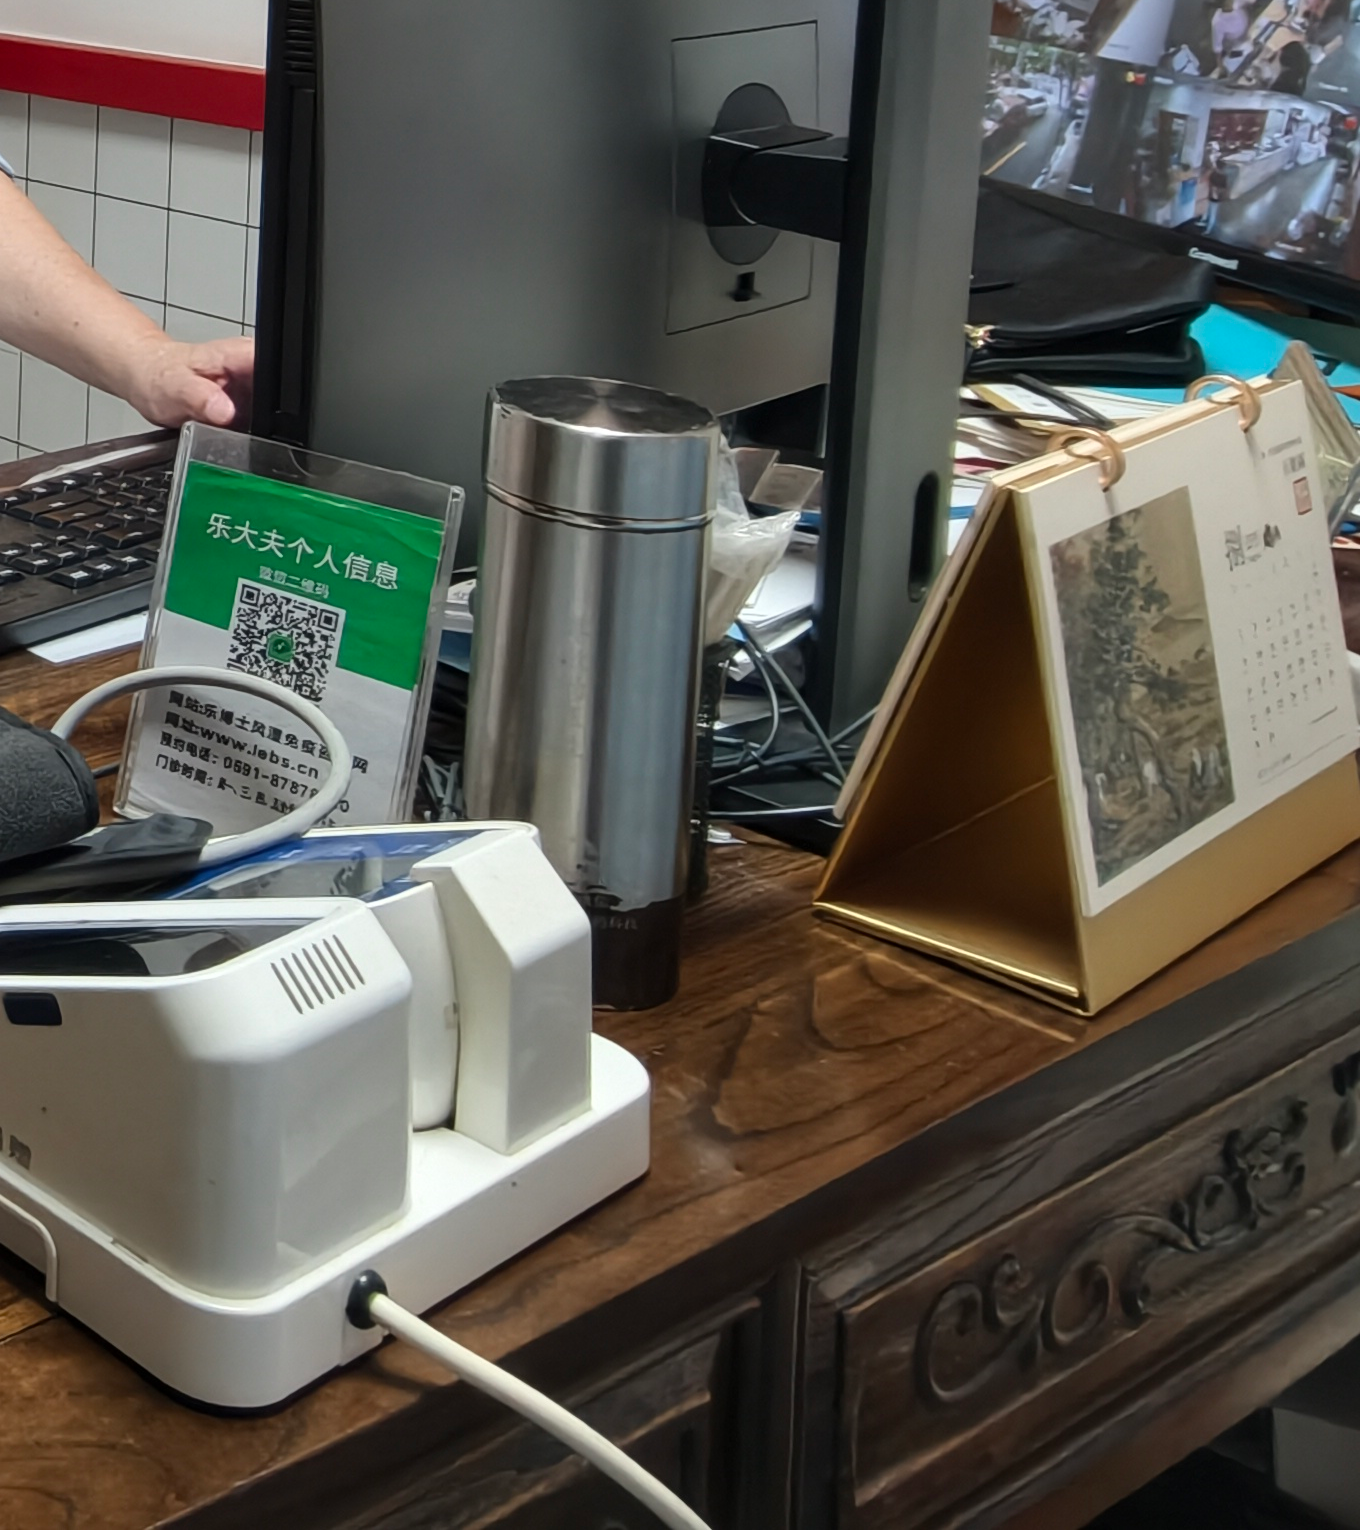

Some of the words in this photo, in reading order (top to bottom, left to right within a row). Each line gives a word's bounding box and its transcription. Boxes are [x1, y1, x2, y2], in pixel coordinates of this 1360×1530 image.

[206, 513, 398, 590] 乐大夫个人信息
